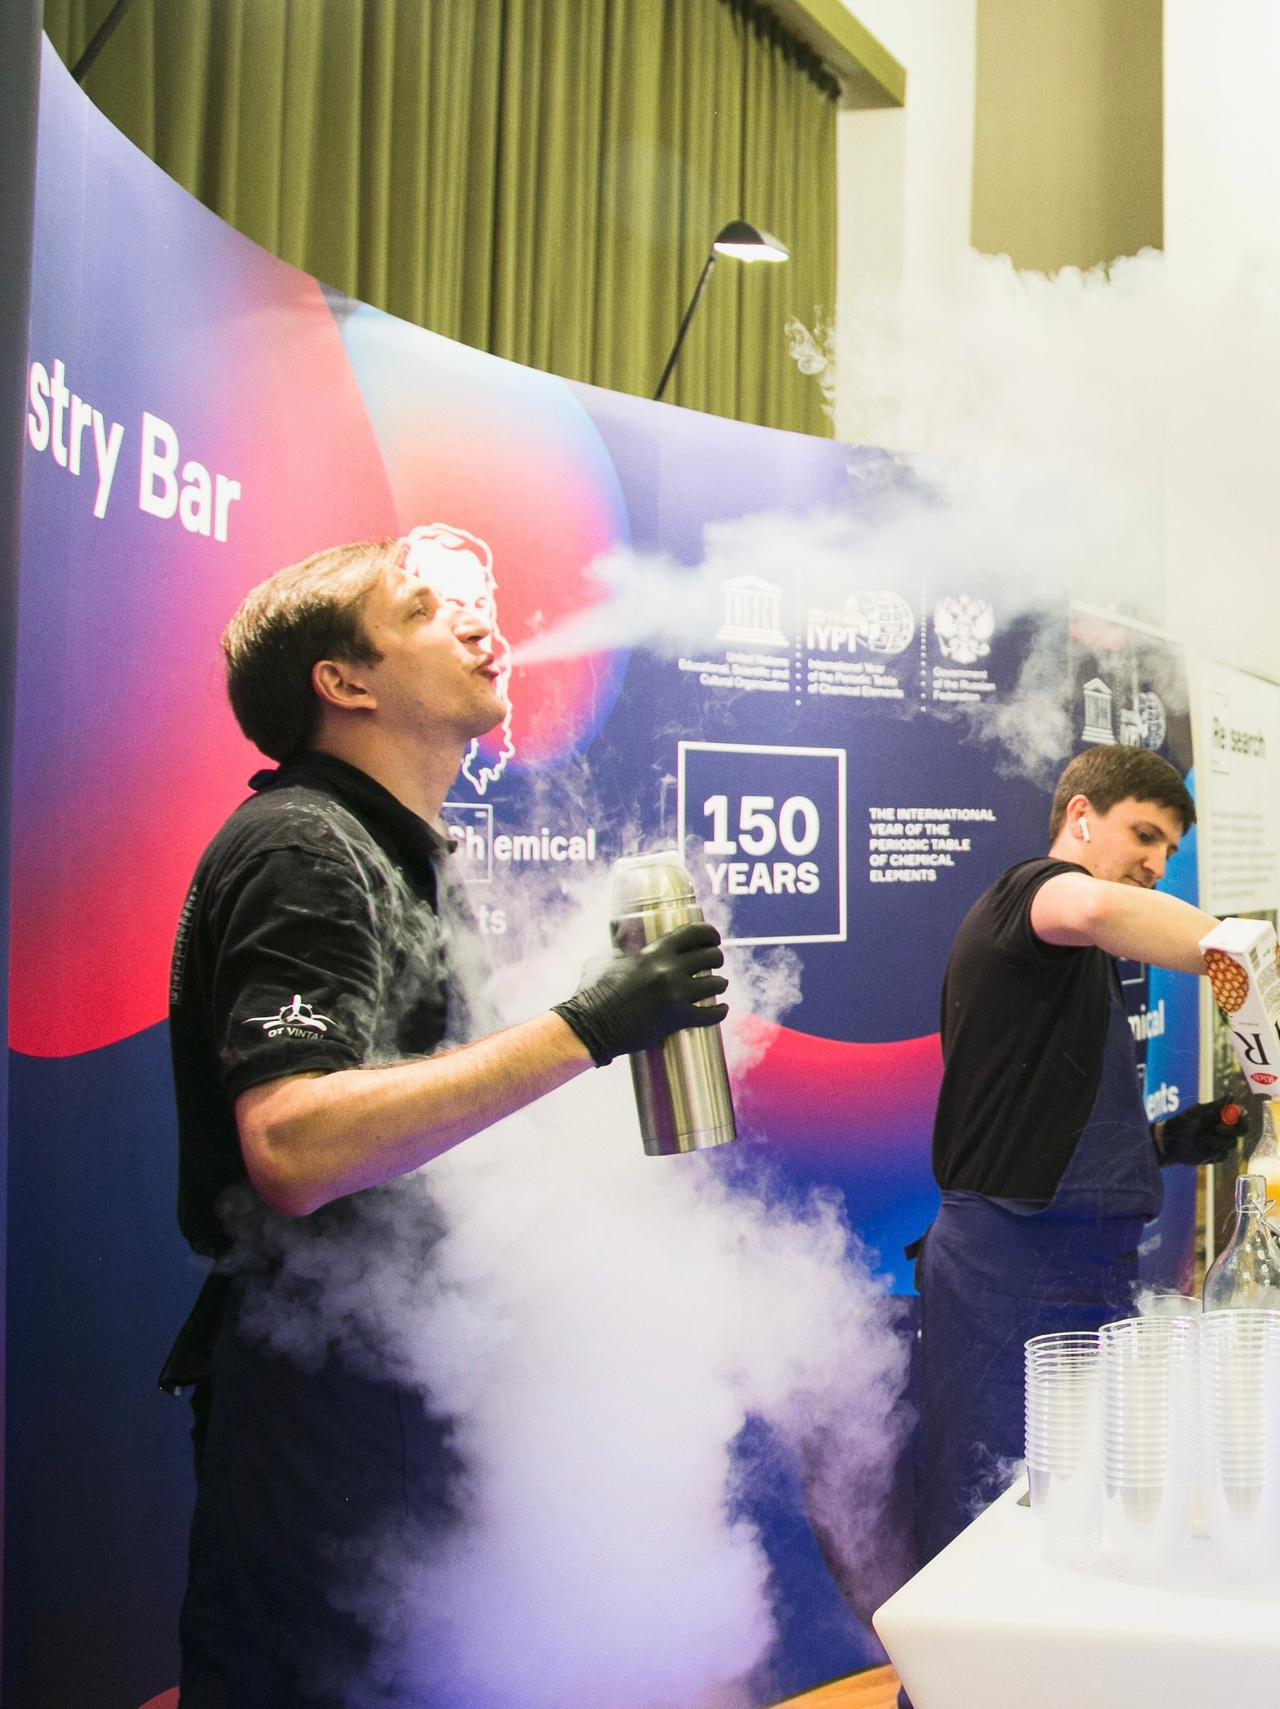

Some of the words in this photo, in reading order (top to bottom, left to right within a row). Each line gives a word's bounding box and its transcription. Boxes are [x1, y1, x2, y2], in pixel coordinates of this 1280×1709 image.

[27, 358, 125, 519] stry
[139, 411, 242, 543] Bar
[806, 624, 861, 653] IYPT
[869, 807, 896, 820] THE
[896, 807, 997, 822] INTERNATIONAL
[703, 794, 820, 856] 150
[869, 823, 904, 836] YEAR
[904, 823, 924, 836] OF
[924, 823, 951, 836] THE
[869, 838, 930, 851] PERIODIC
[930, 838, 972, 851] TABLE
[869, 854, 888, 867] OF
[888, 854, 956, 867] CHEMICAL
[704, 861, 820, 895] YEARS
[869, 869, 938, 882] ELEMENTS
[268, 1027, 285, 1038] OT
[1233, 1030, 1271, 1066] R
